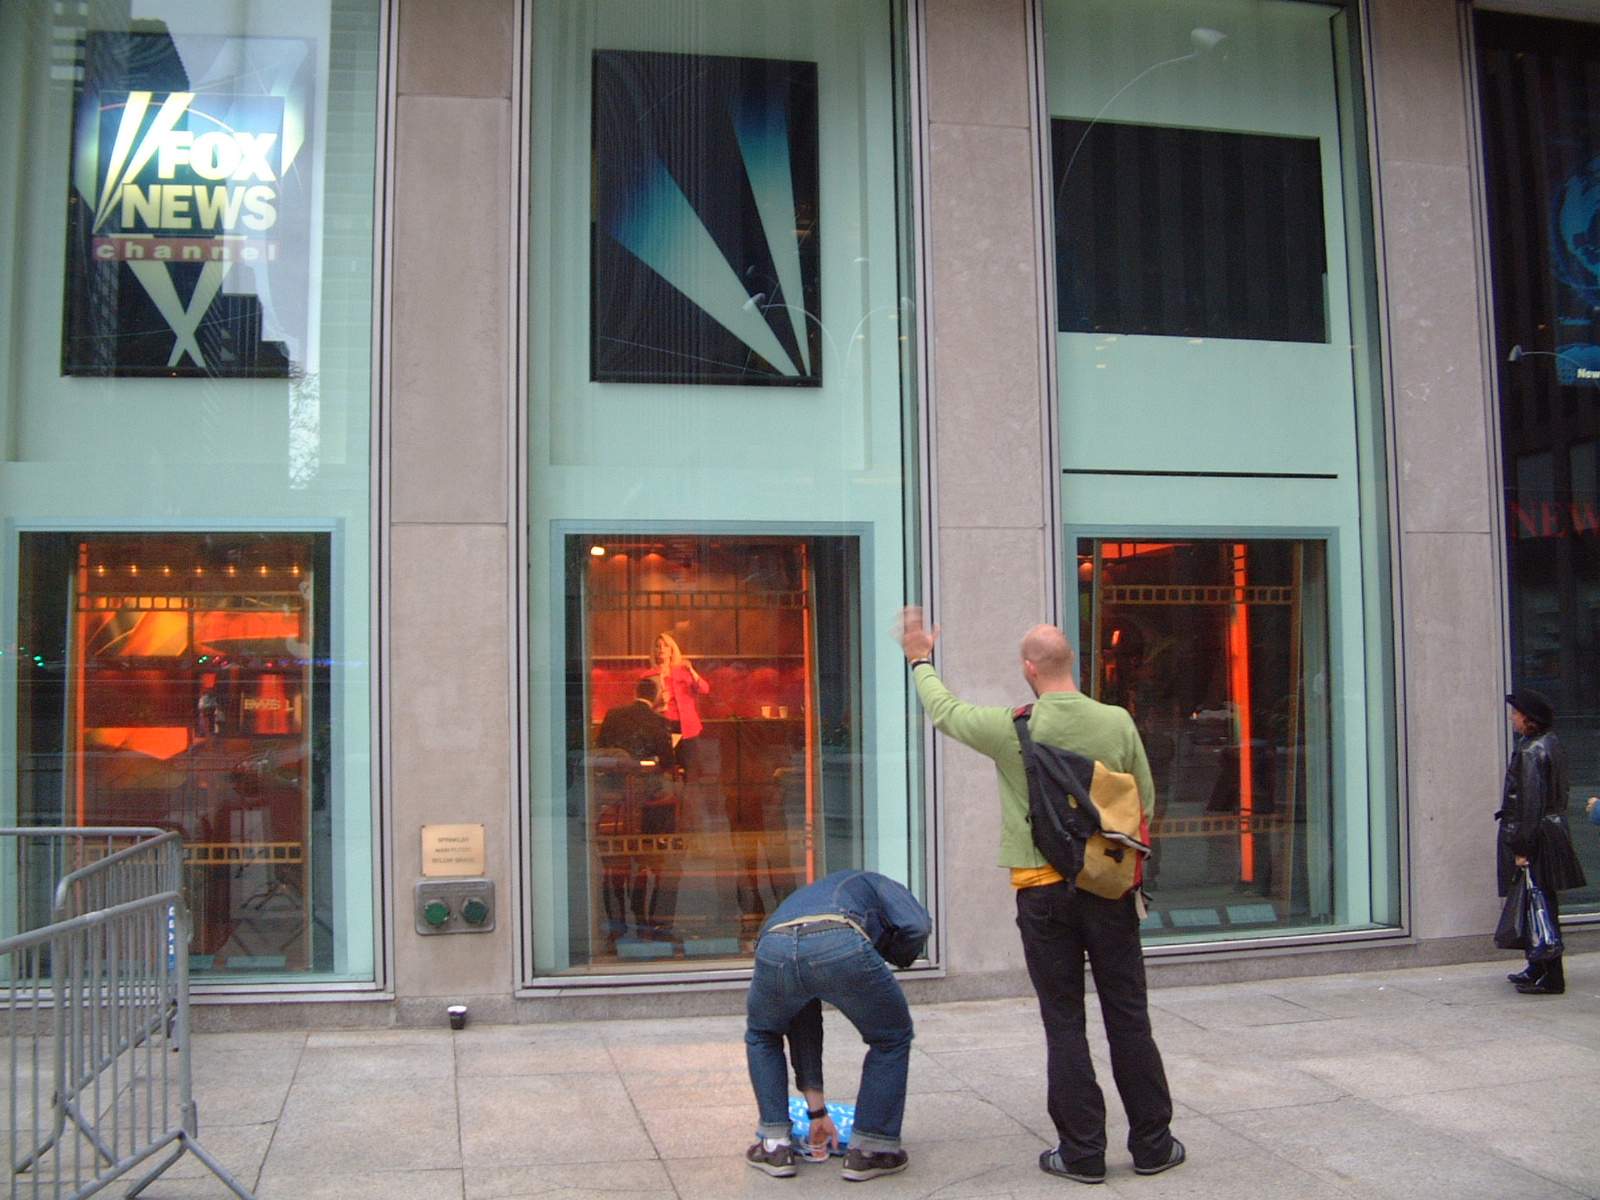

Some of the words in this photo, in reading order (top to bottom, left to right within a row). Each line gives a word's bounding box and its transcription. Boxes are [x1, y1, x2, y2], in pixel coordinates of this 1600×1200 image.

[157, 130, 278, 182] FOX
[120, 183, 278, 232] NEWS
[95, 240, 277, 261] channel
